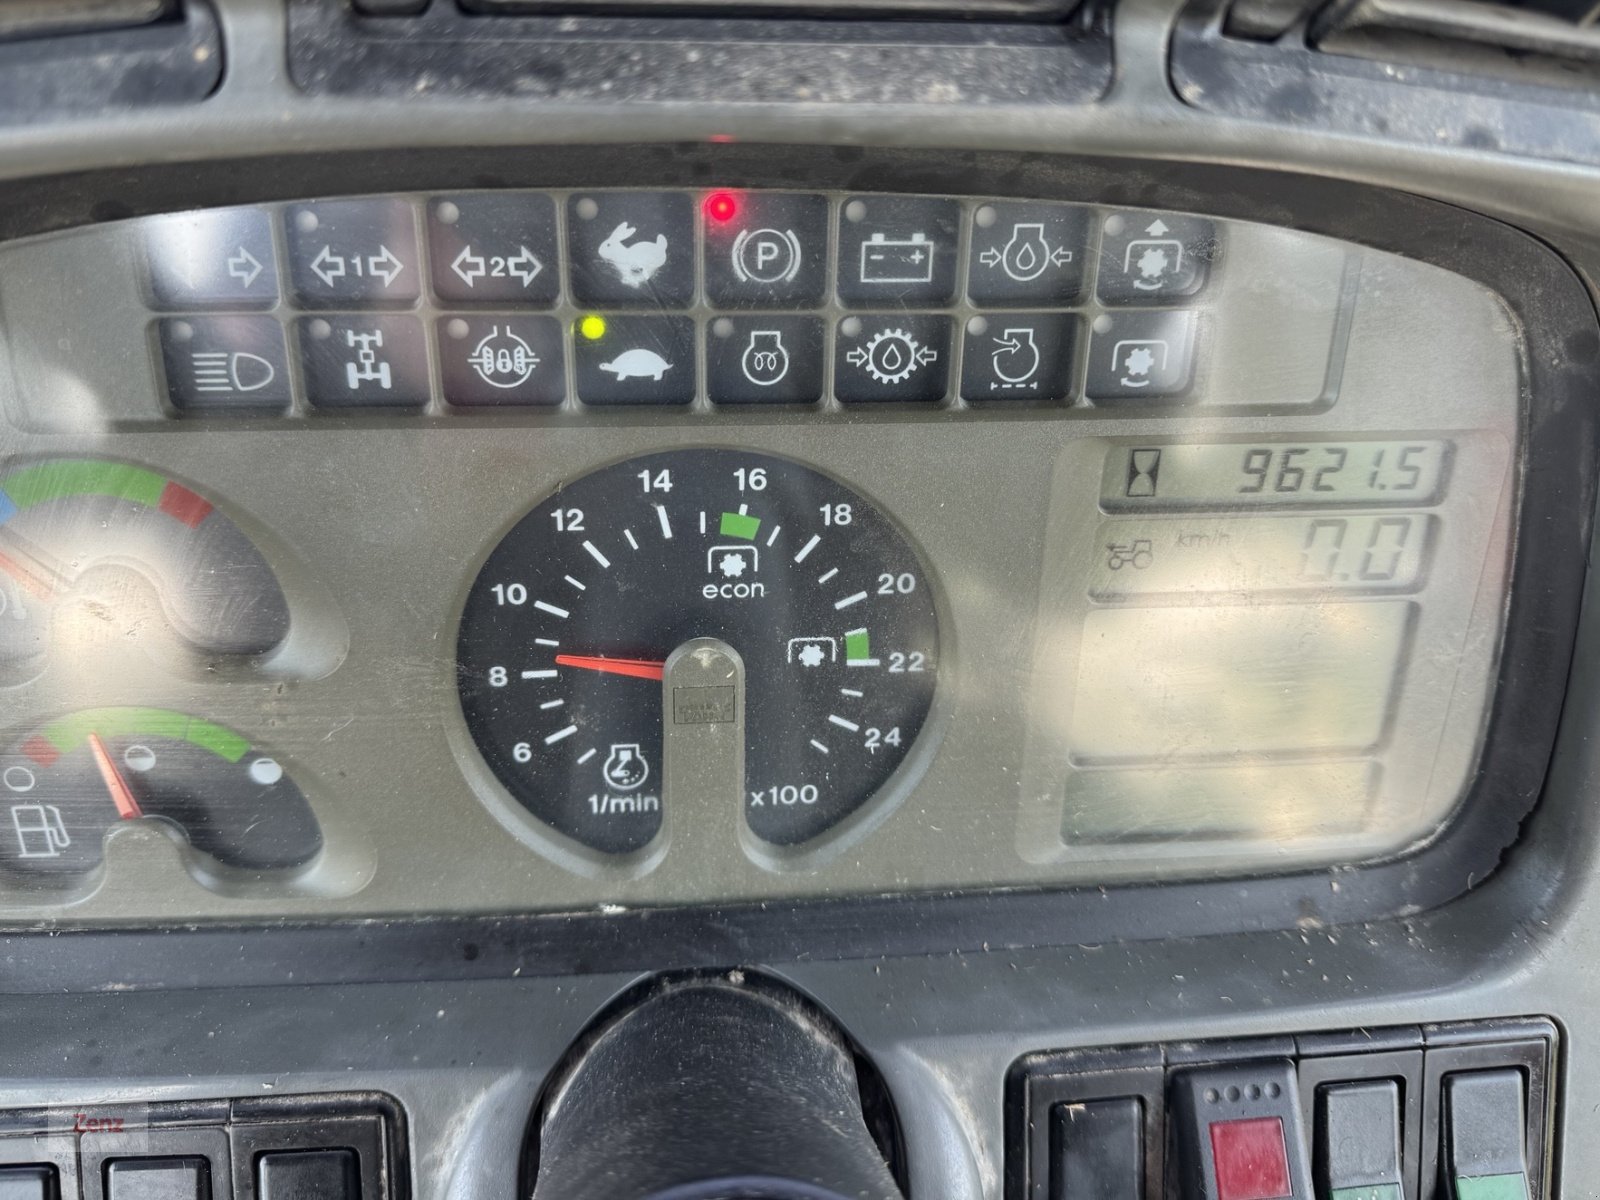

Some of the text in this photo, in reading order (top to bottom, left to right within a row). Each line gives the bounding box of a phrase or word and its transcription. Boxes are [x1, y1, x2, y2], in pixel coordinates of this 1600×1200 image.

[757, 240, 780, 269] P
[351, 257, 364, 276] 1
[490, 256, 507, 277] 2
[637, 470, 673, 492] 14
[733, 468, 767, 491] 16
[1239, 447, 1427, 493] 9621.5
[550, 509, 585, 532] 12
[819, 503, 853, 526] 18
[491, 583, 528, 605] 10
[703, 581, 765, 599] econ
[877, 573, 916, 596] 20
[888, 653, 926, 674] 22
[488, 667, 508, 687] 8
[863, 727, 901, 749] 24
[512, 744, 532, 763] 6
[588, 793, 660, 815] 1/min
[750, 786, 818, 807] x100
